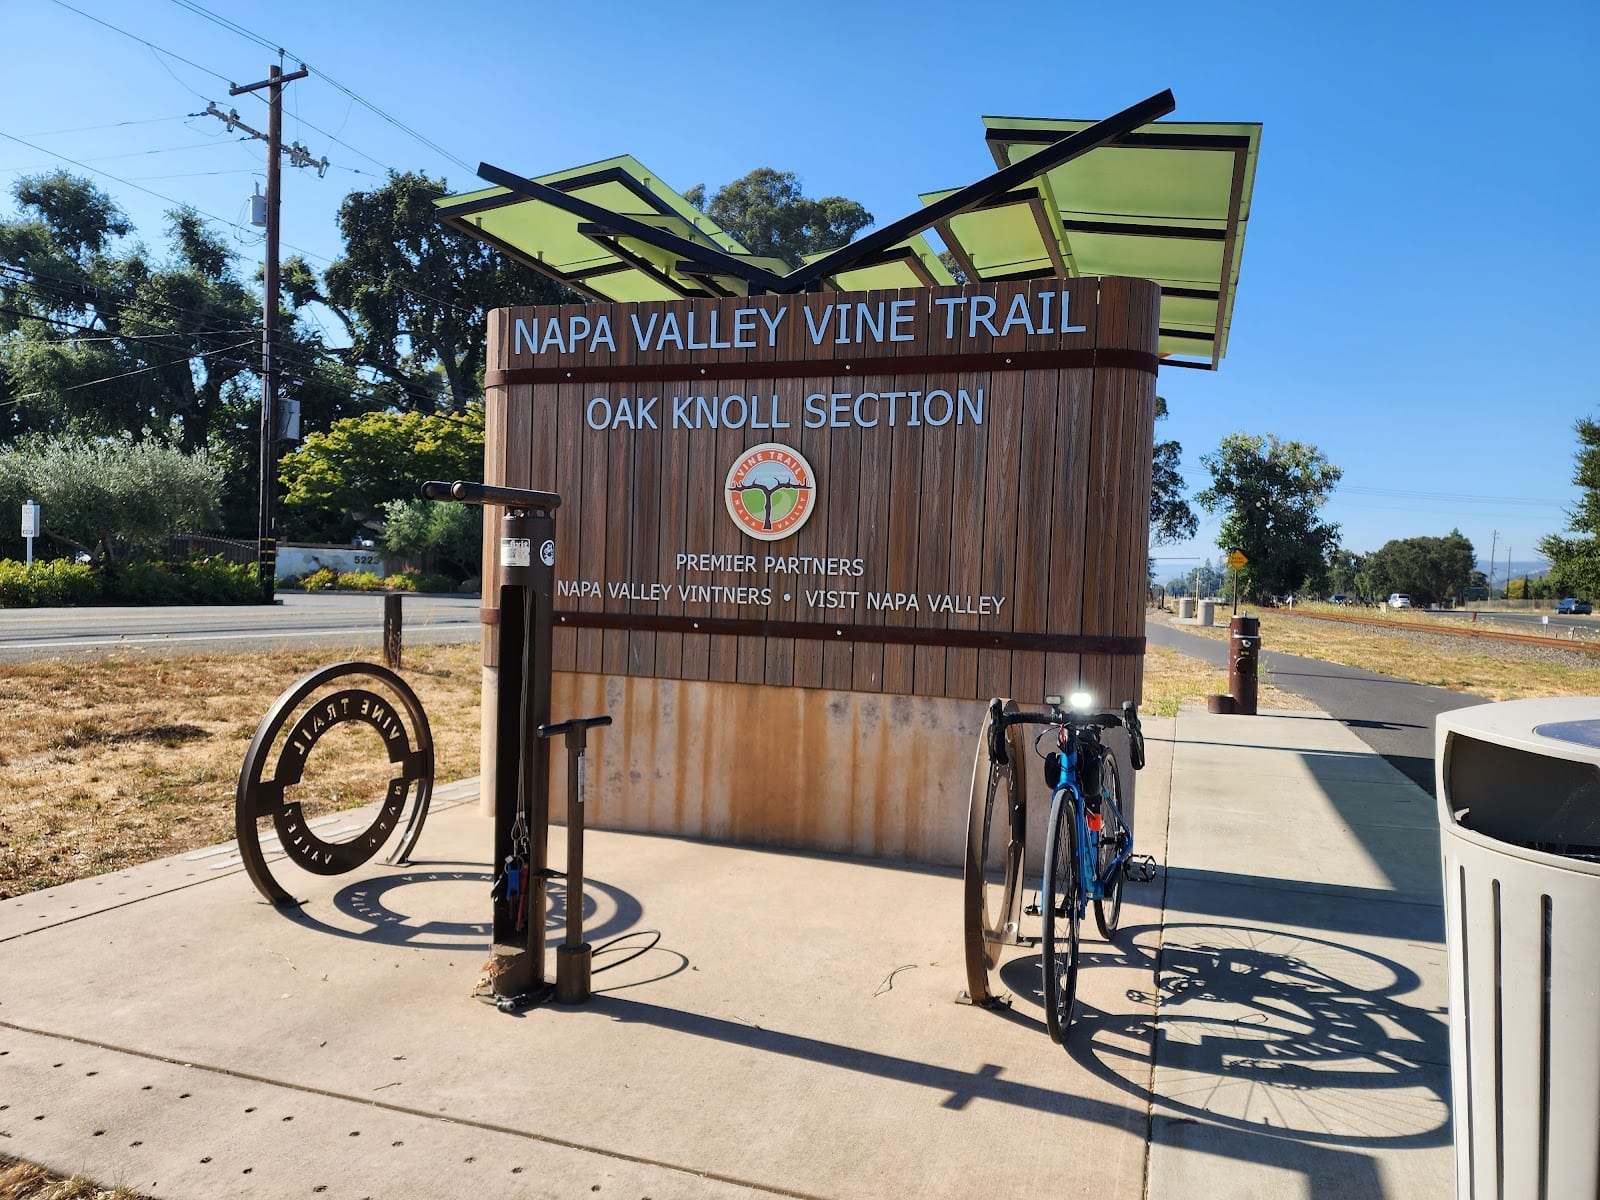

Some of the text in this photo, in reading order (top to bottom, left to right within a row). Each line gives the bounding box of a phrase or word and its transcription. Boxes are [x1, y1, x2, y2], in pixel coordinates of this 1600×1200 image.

[514, 290, 1087, 355] NAPA VALLEY VINE TRAIL
[586, 389, 984, 430] OAK KNOLL SECTION
[737, 451, 801, 477] VINE TRAIL
[735, 497, 807, 529] NAPA VALLEY
[676, 553, 865, 577] PREMIER PARTNERS
[557, 580, 1006, 615] NAPA VALLEY VINTNERS VISIT NAPA VALLEY
